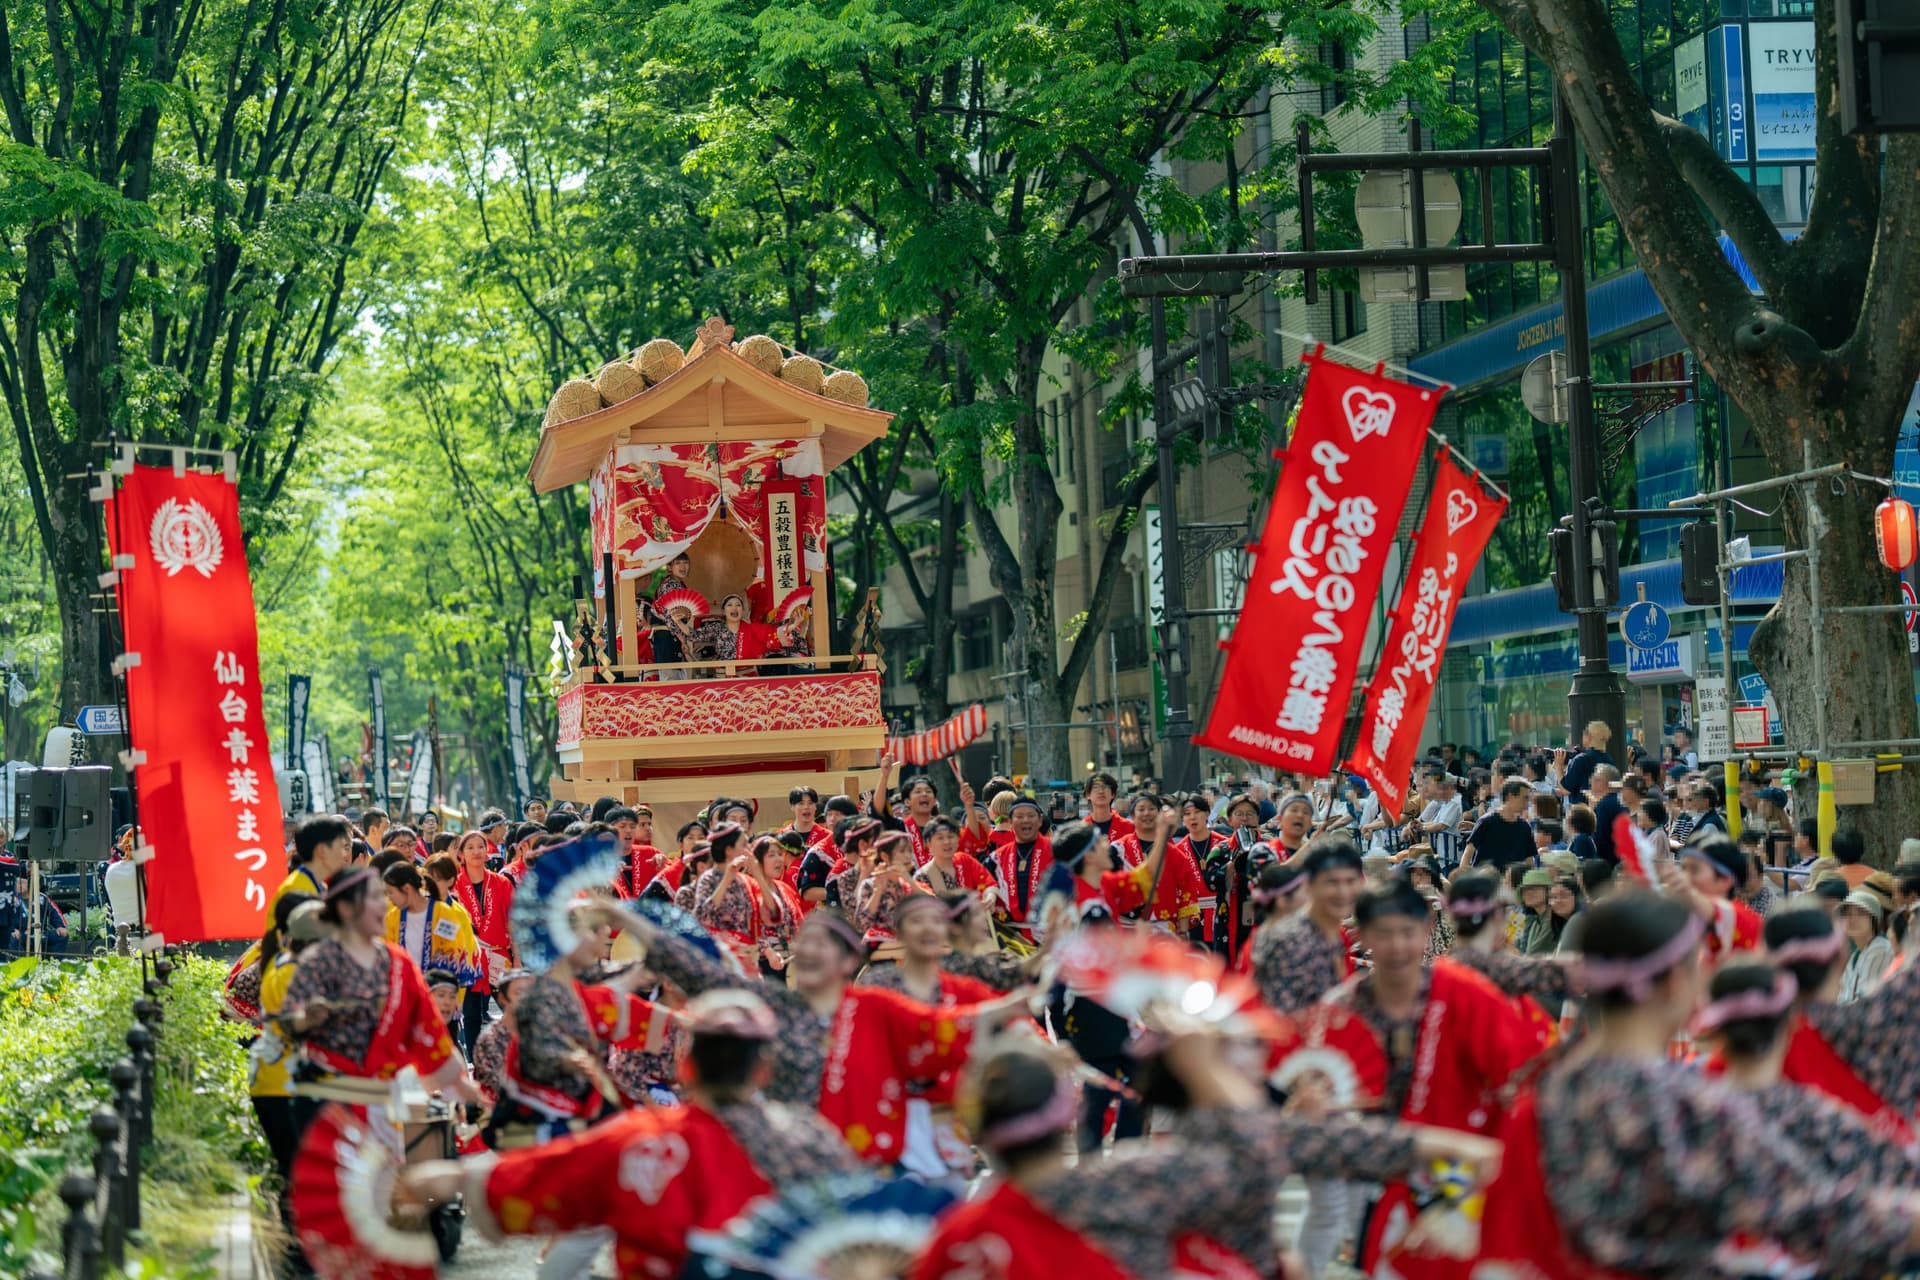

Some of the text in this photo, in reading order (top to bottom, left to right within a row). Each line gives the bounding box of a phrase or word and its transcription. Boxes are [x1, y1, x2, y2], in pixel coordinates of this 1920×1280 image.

[1680, 61, 1703, 83] TRYVE
[1629, 642, 1680, 671] LAWSON
[213, 650, 269, 912] 仙台青葉まつり
